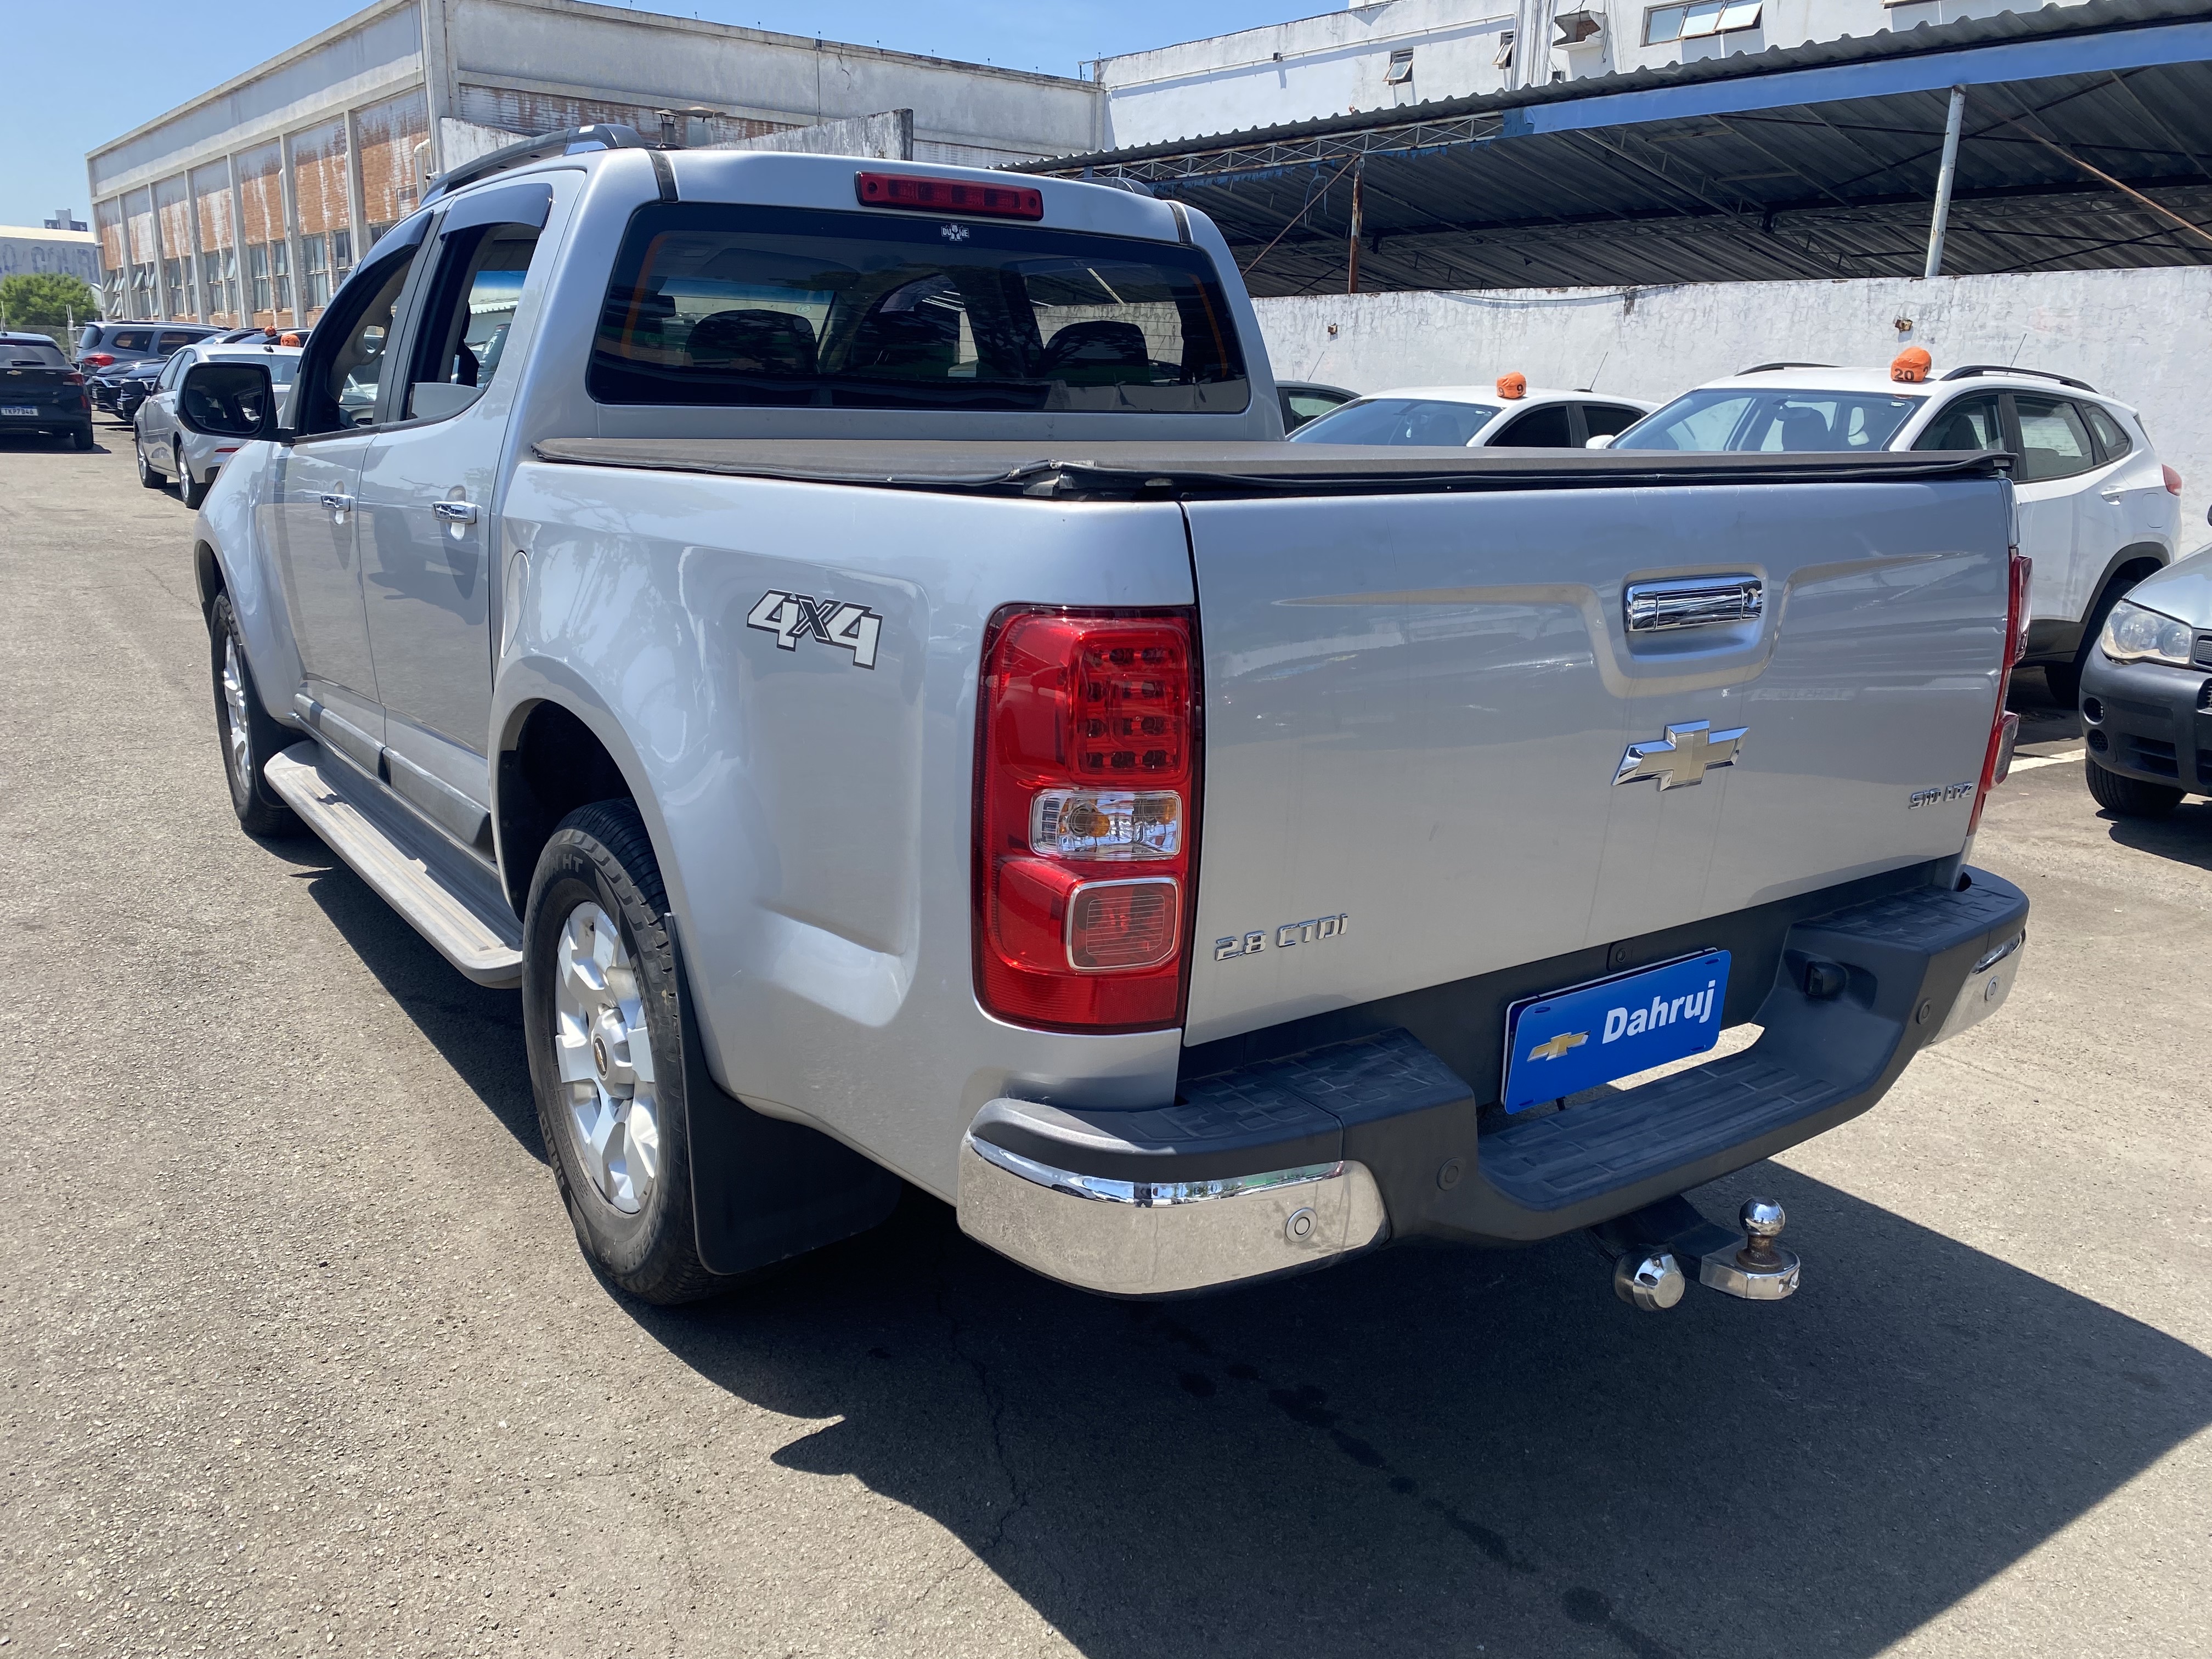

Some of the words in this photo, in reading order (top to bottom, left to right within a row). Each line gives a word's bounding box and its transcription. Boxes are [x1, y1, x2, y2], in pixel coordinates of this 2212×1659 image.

[1894, 368, 1915, 381] 20
[1517, 384, 1523, 394] 9
[1908, 788, 1942, 809] S10
[1943, 781, 1974, 802] LTZ
[1215, 930, 1267, 961] 2.8
[1277, 913, 1348, 948] CTDI
[1602, 979, 1716, 1044] Dahruj
